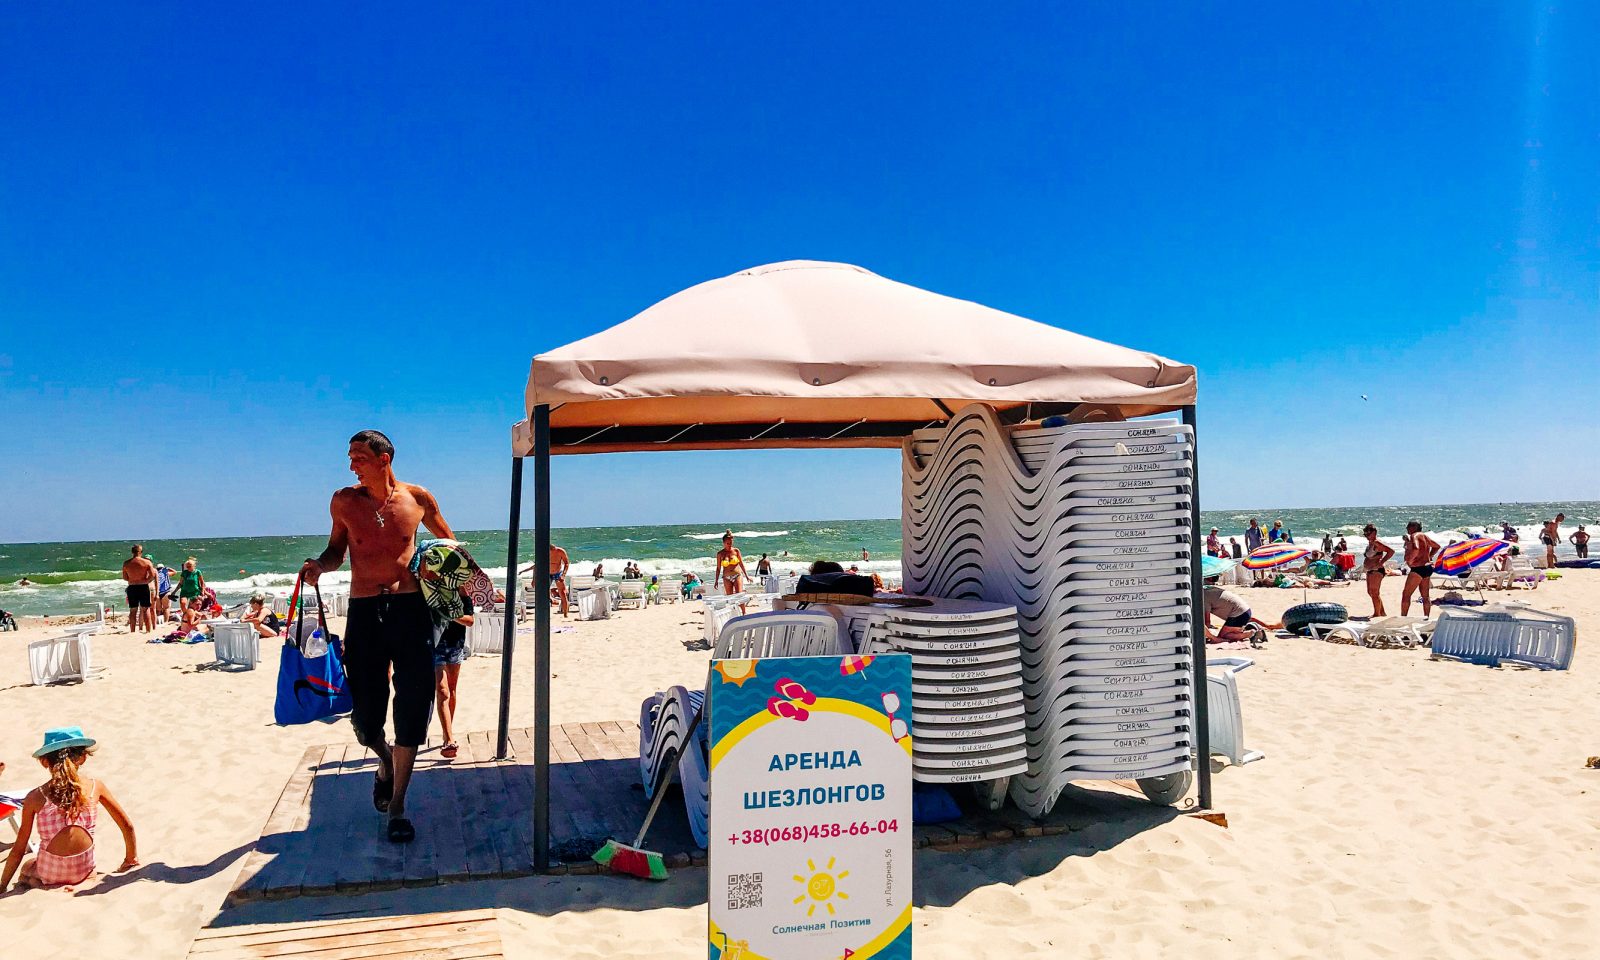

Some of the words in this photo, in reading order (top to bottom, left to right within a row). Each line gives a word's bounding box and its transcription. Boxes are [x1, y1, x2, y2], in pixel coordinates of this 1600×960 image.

[768, 749, 862, 772] АРЕНДА
[743, 783, 885, 810] ШЕЗЛОНГОВ
[728, 819, 899, 847] +38(068)458-66-04
[884, 859, 894, 896] Лазурная,
[886, 896, 894, 907] ул.
[772, 922, 826, 935] Солнечная
[830, 918, 872, 929] Позитив
